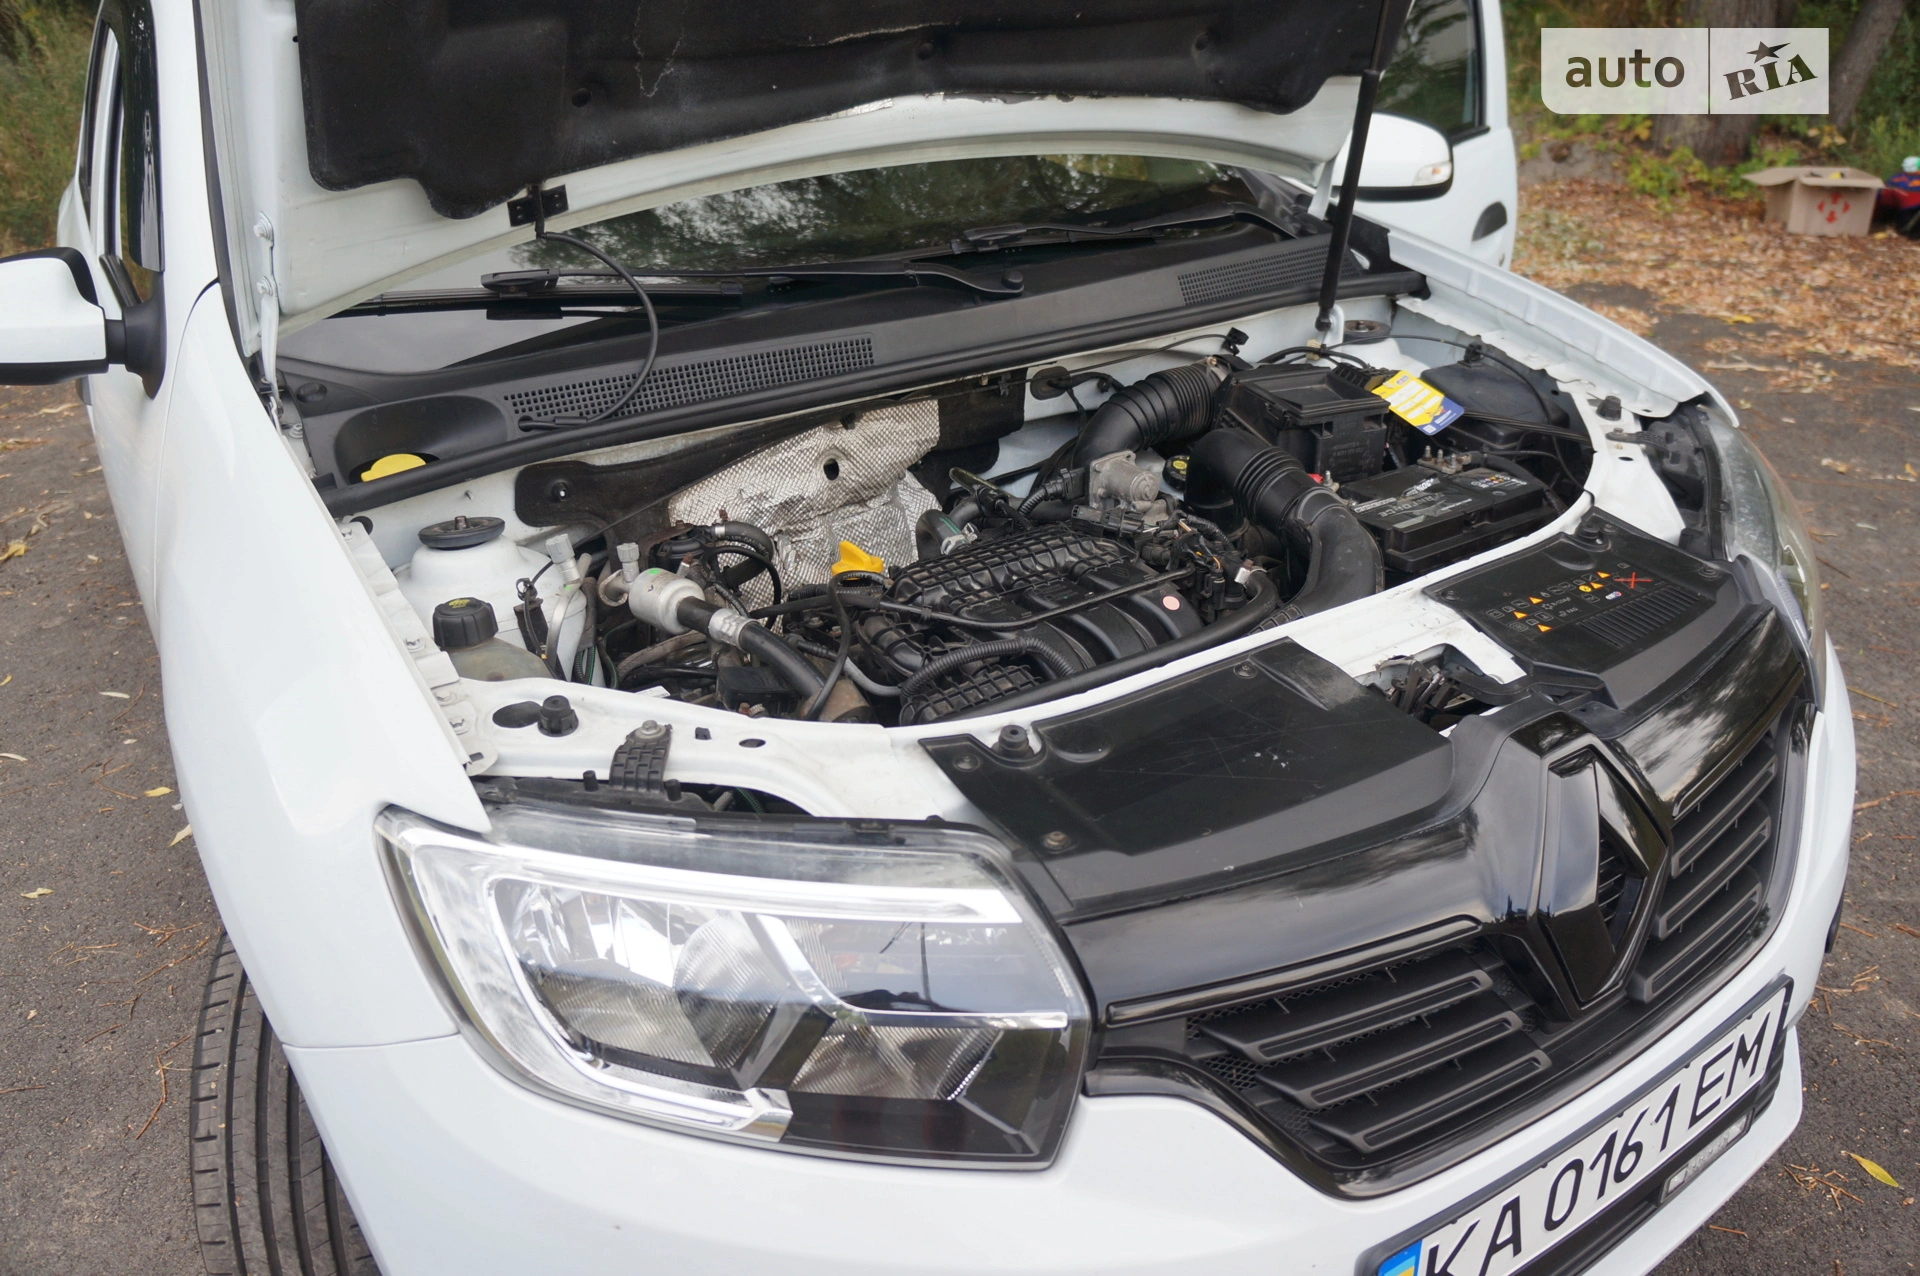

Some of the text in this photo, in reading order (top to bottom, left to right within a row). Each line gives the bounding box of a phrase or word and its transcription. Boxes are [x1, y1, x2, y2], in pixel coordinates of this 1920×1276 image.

[1425, 1011, 1771, 1276] KA 0161 EM
